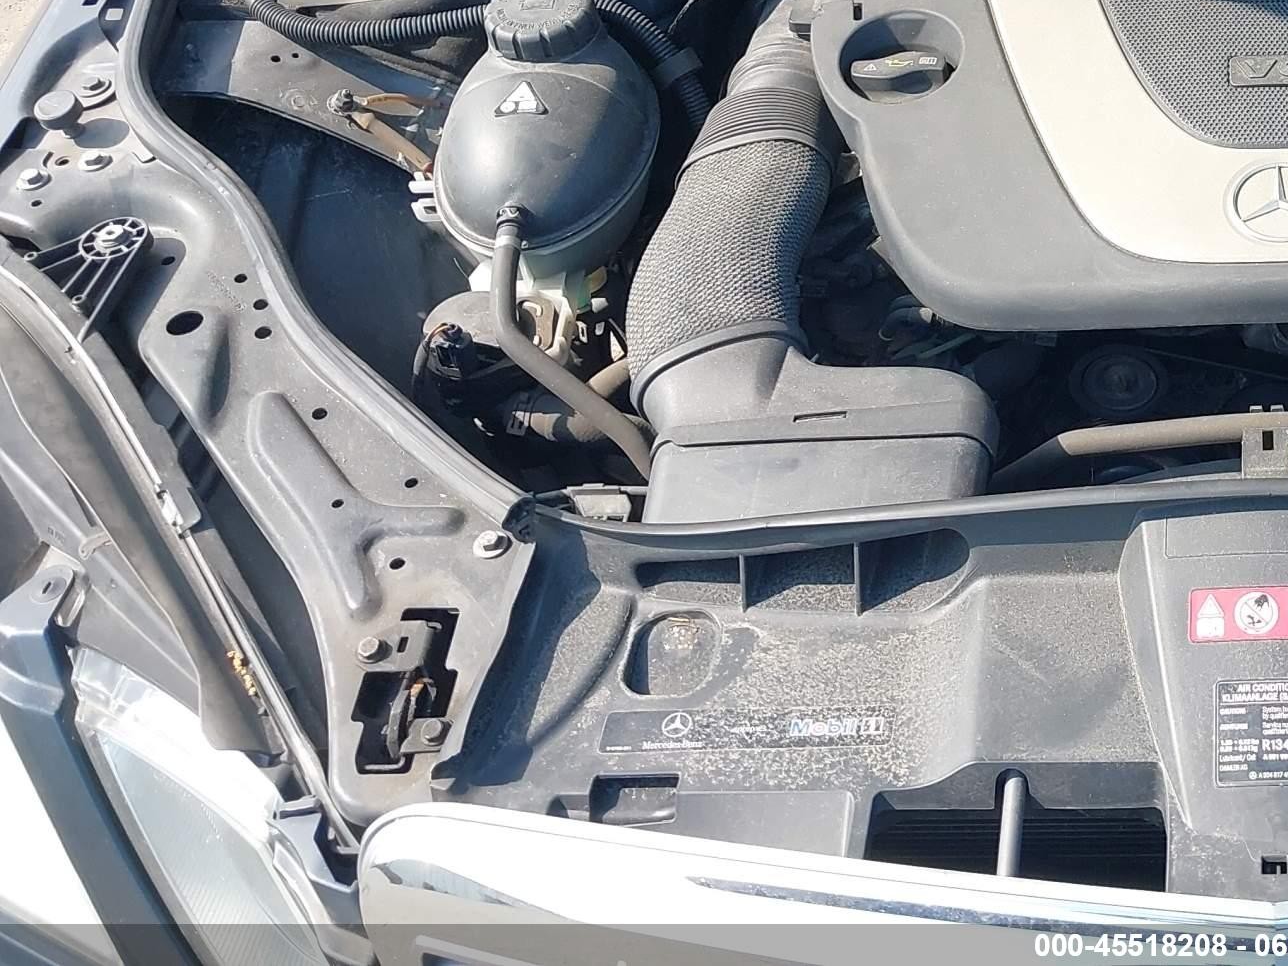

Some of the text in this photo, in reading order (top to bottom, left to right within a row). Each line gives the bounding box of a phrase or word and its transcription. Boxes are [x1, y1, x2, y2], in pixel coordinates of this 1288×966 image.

[1237, 684, 1251, 692] AIR
[1222, 693, 1278, 702] KLIMAANLAGE
[790, 718, 858, 736] Mobil
